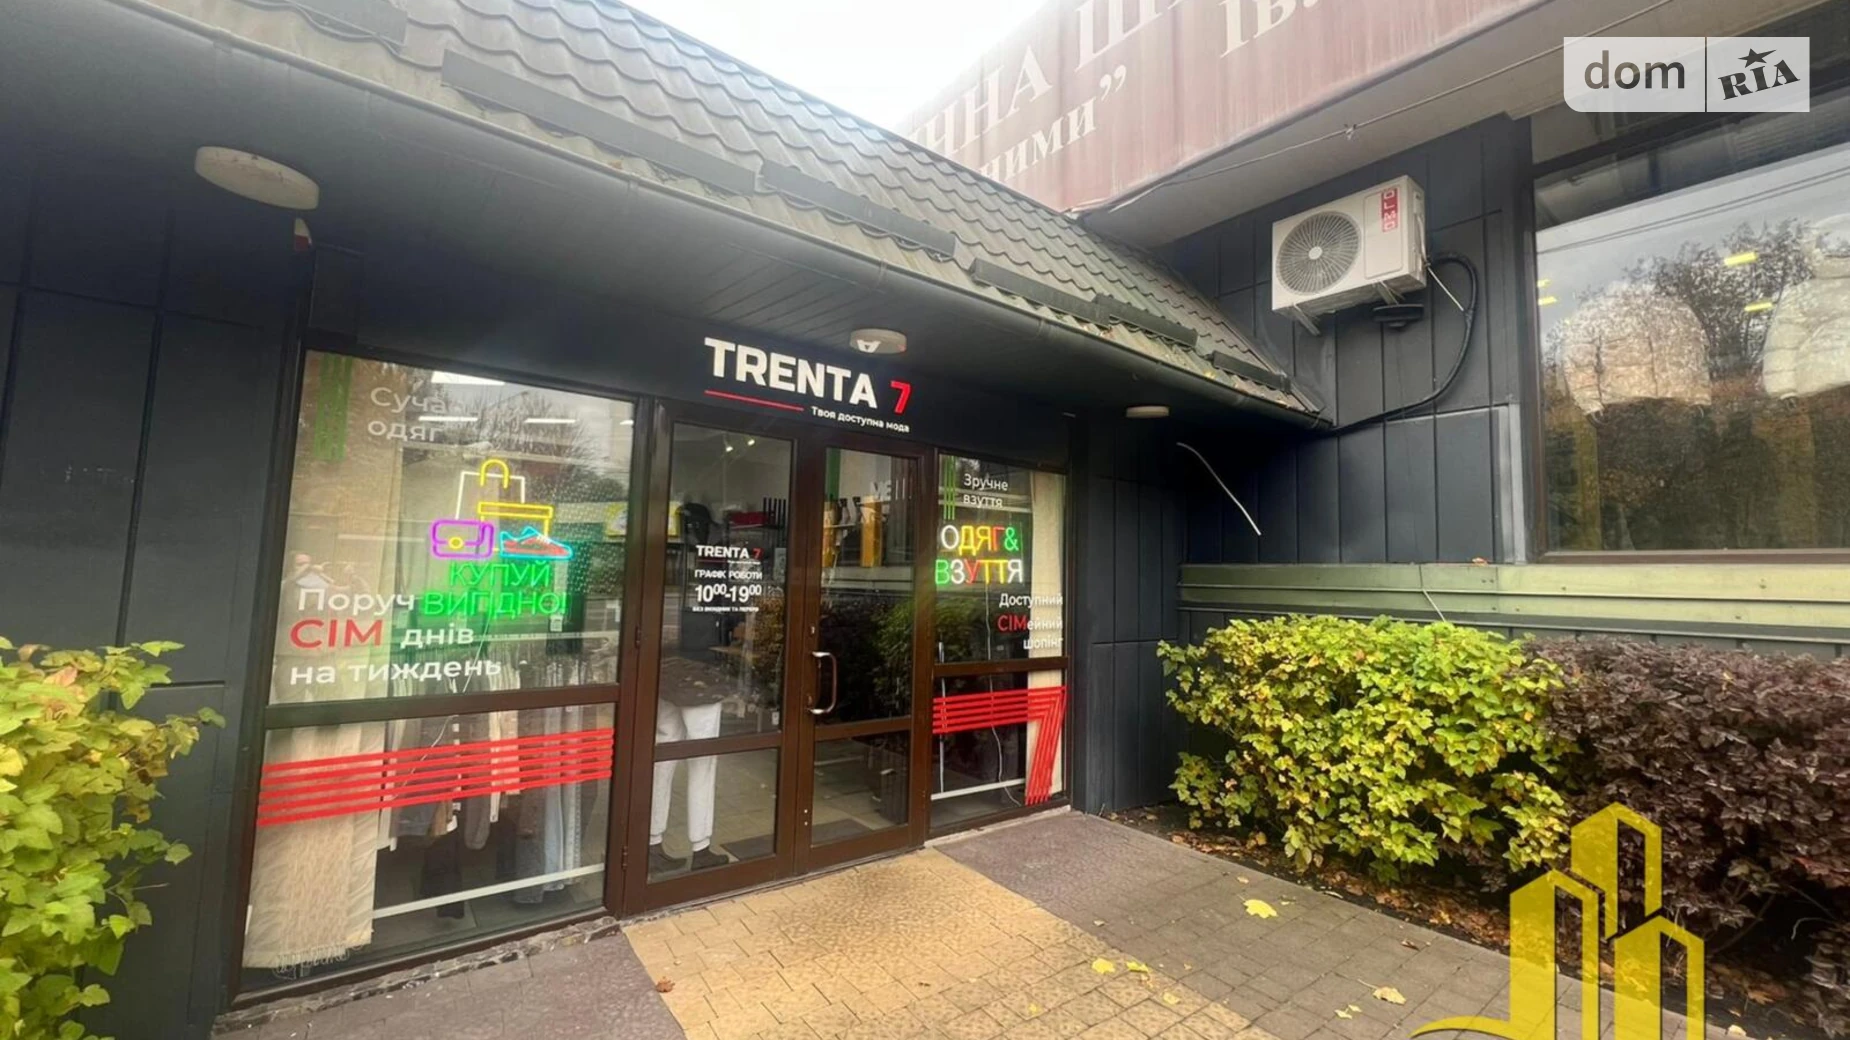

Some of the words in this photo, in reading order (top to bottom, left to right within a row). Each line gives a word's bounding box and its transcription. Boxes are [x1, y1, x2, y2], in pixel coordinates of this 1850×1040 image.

[704, 337, 878, 409] TRENTA
[890, 379, 912, 414] 7
[811, 406, 836, 419] Твоя
[838, 413, 884, 427] доступна
[886, 422, 910, 433] мода
[367, 420, 444, 442] одяг
[963, 473, 1009, 491] Зручне
[963, 494, 1003, 509] взуття
[695, 544, 750, 559] TRENTA
[752, 547, 762, 560] 7
[450, 560, 551, 587] КУПУЙ
[729, 570, 763, 580] РОБОТИ
[934, 558, 1024, 586] ВЗУТТЯ
[298, 588, 415, 616] Поруч
[999, 592, 1063, 609] Доступний
[290, 619, 383, 648] СІМ
[400, 622, 475, 648] днів
[997, 614, 1063, 631] СІМейний
[1023, 635, 1063, 650] шопінг
[290, 665, 336, 685] на
[347, 659, 502, 682] тиждень
